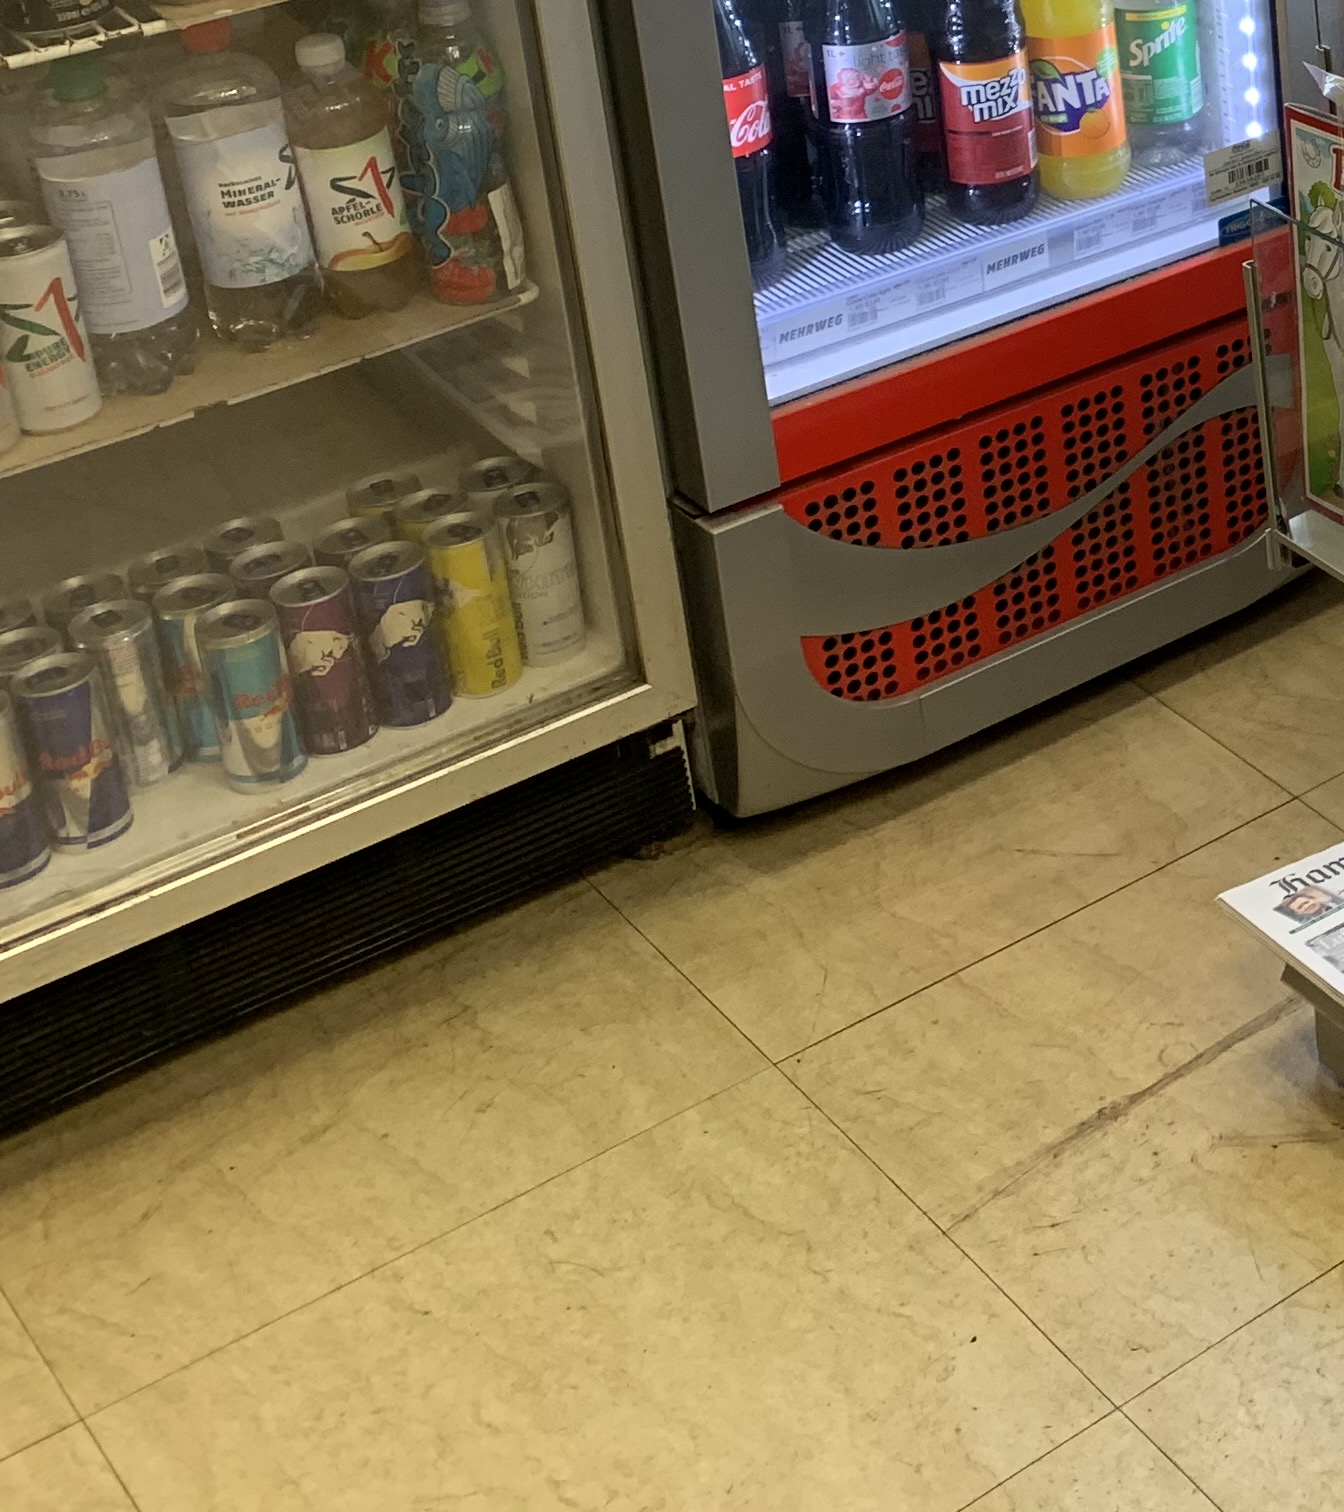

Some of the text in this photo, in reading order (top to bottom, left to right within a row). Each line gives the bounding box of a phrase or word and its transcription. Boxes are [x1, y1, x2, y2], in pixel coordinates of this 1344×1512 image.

[1129, 18, 1188, 69] Sprite
[223, 190, 274, 210] WASSER
[986, 243, 1045, 276] MEHRWEG
